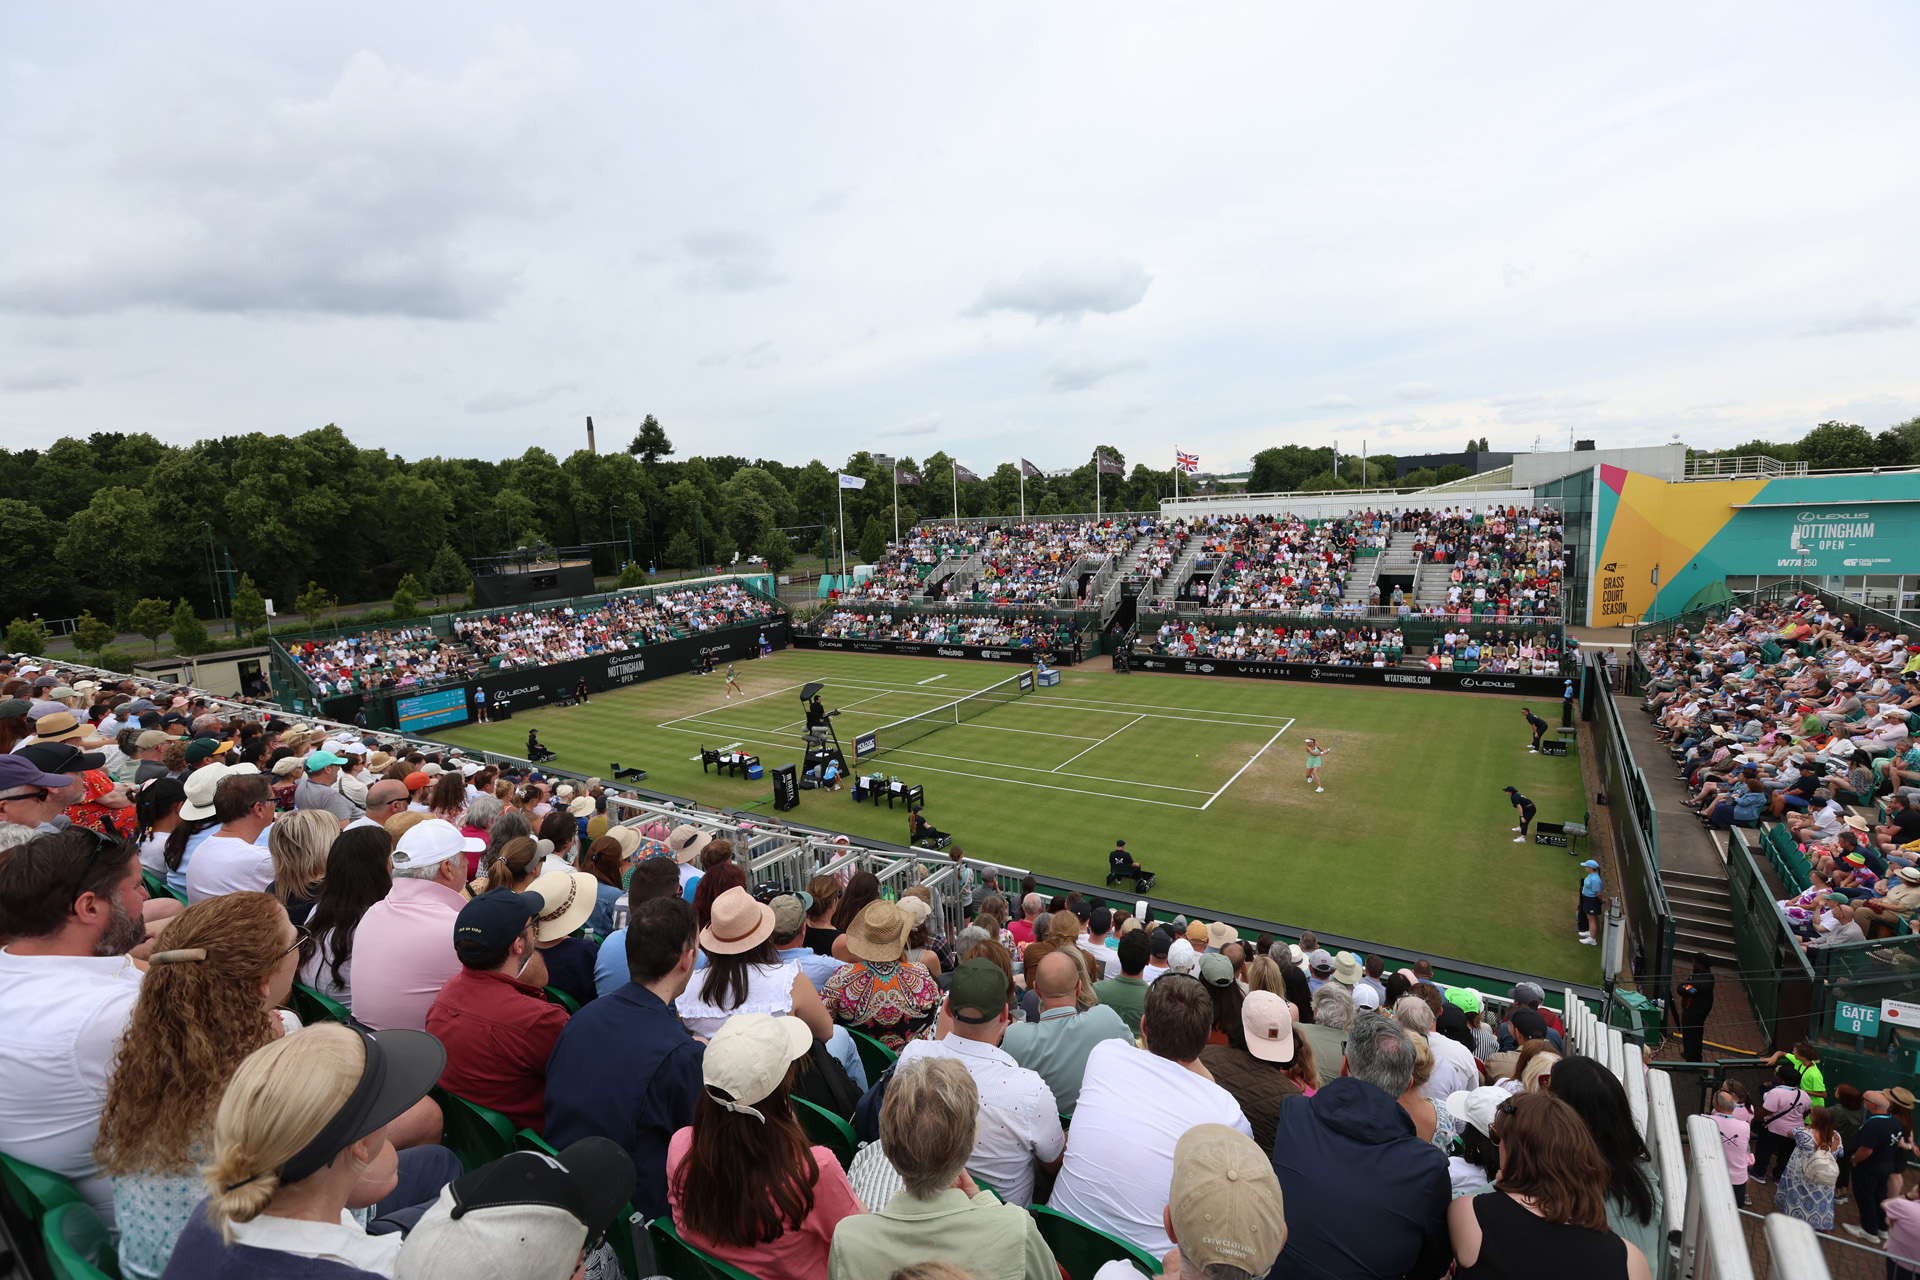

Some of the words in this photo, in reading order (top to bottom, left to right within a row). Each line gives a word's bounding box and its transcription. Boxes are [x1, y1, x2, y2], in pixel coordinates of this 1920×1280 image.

[1793, 523, 1875, 538] NOTTINGHAM
[1819, 540, 1844, 550] OPEN
[1604, 576, 1624, 589] GRASS
[1603, 590, 1623, 602] COURT
[1602, 602, 1627, 615] SEASON
[618, 653, 642, 661] LEXUS
[608, 660, 645, 678] NOTTINGHAM
[1250, 667, 1290, 675] CASTORE
[1384, 674, 1431, 684] WTATENNIS.COM
[507, 685, 540, 697] LEXUS
[787, 779, 795, 801] BRITA
[1842, 1005, 1874, 1022] GATE
[1852, 1020, 1862, 1032] 8
[1202, 1236, 1221, 1246] CREW
[1215, 1246, 1246, 1258] COMPANY
